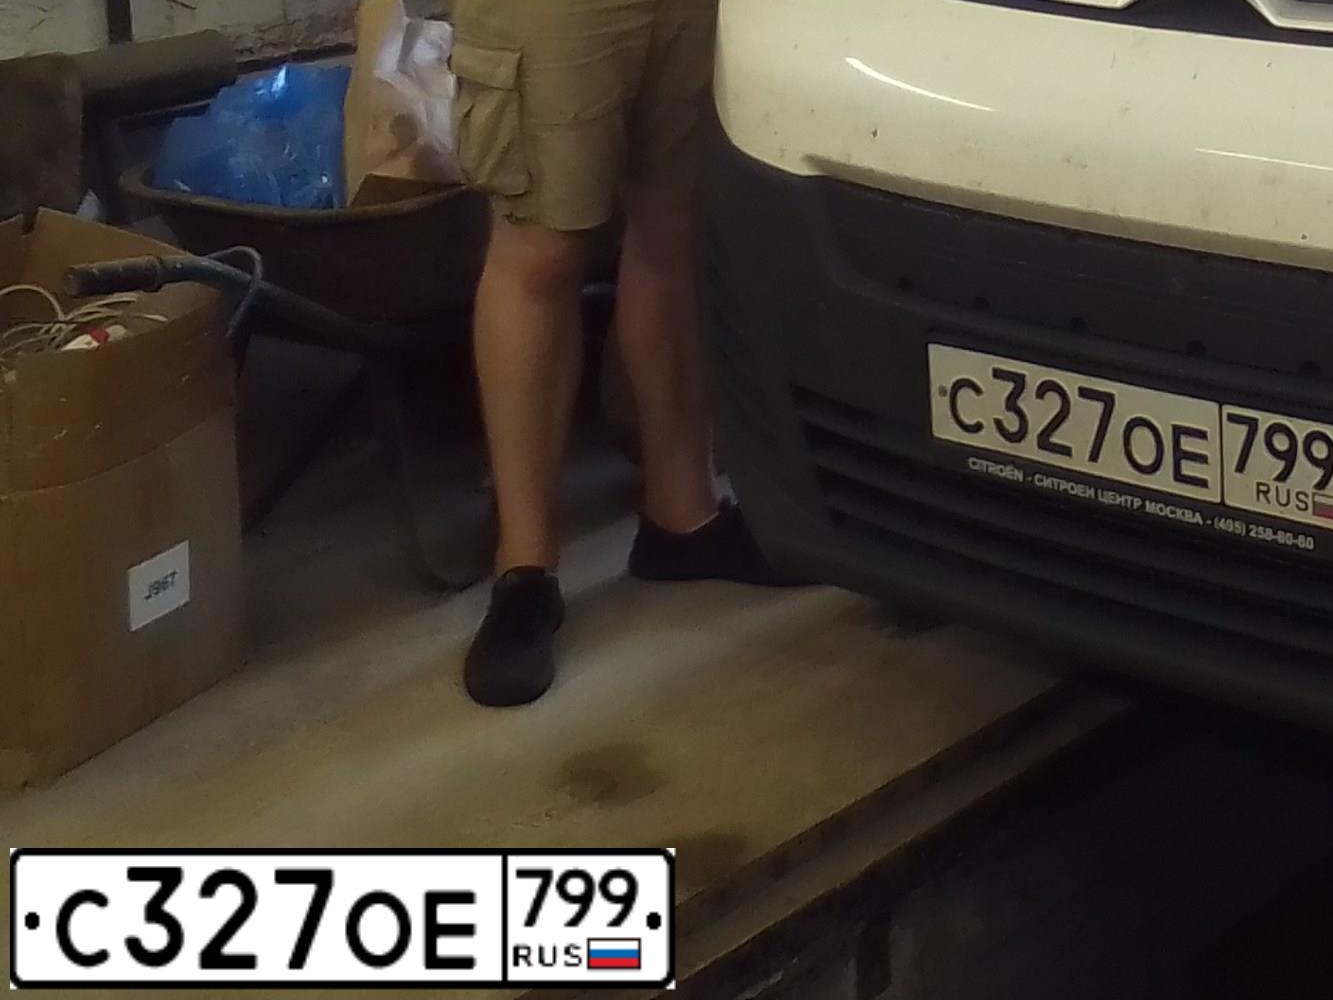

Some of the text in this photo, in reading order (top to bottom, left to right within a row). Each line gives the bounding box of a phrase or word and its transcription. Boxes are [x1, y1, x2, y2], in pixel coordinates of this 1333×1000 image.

[1097, 488, 1143, 511] ЦЕНТР
[1144, 502, 1204, 526] МОСКВА
[1255, 481, 1309, 512] RUS
